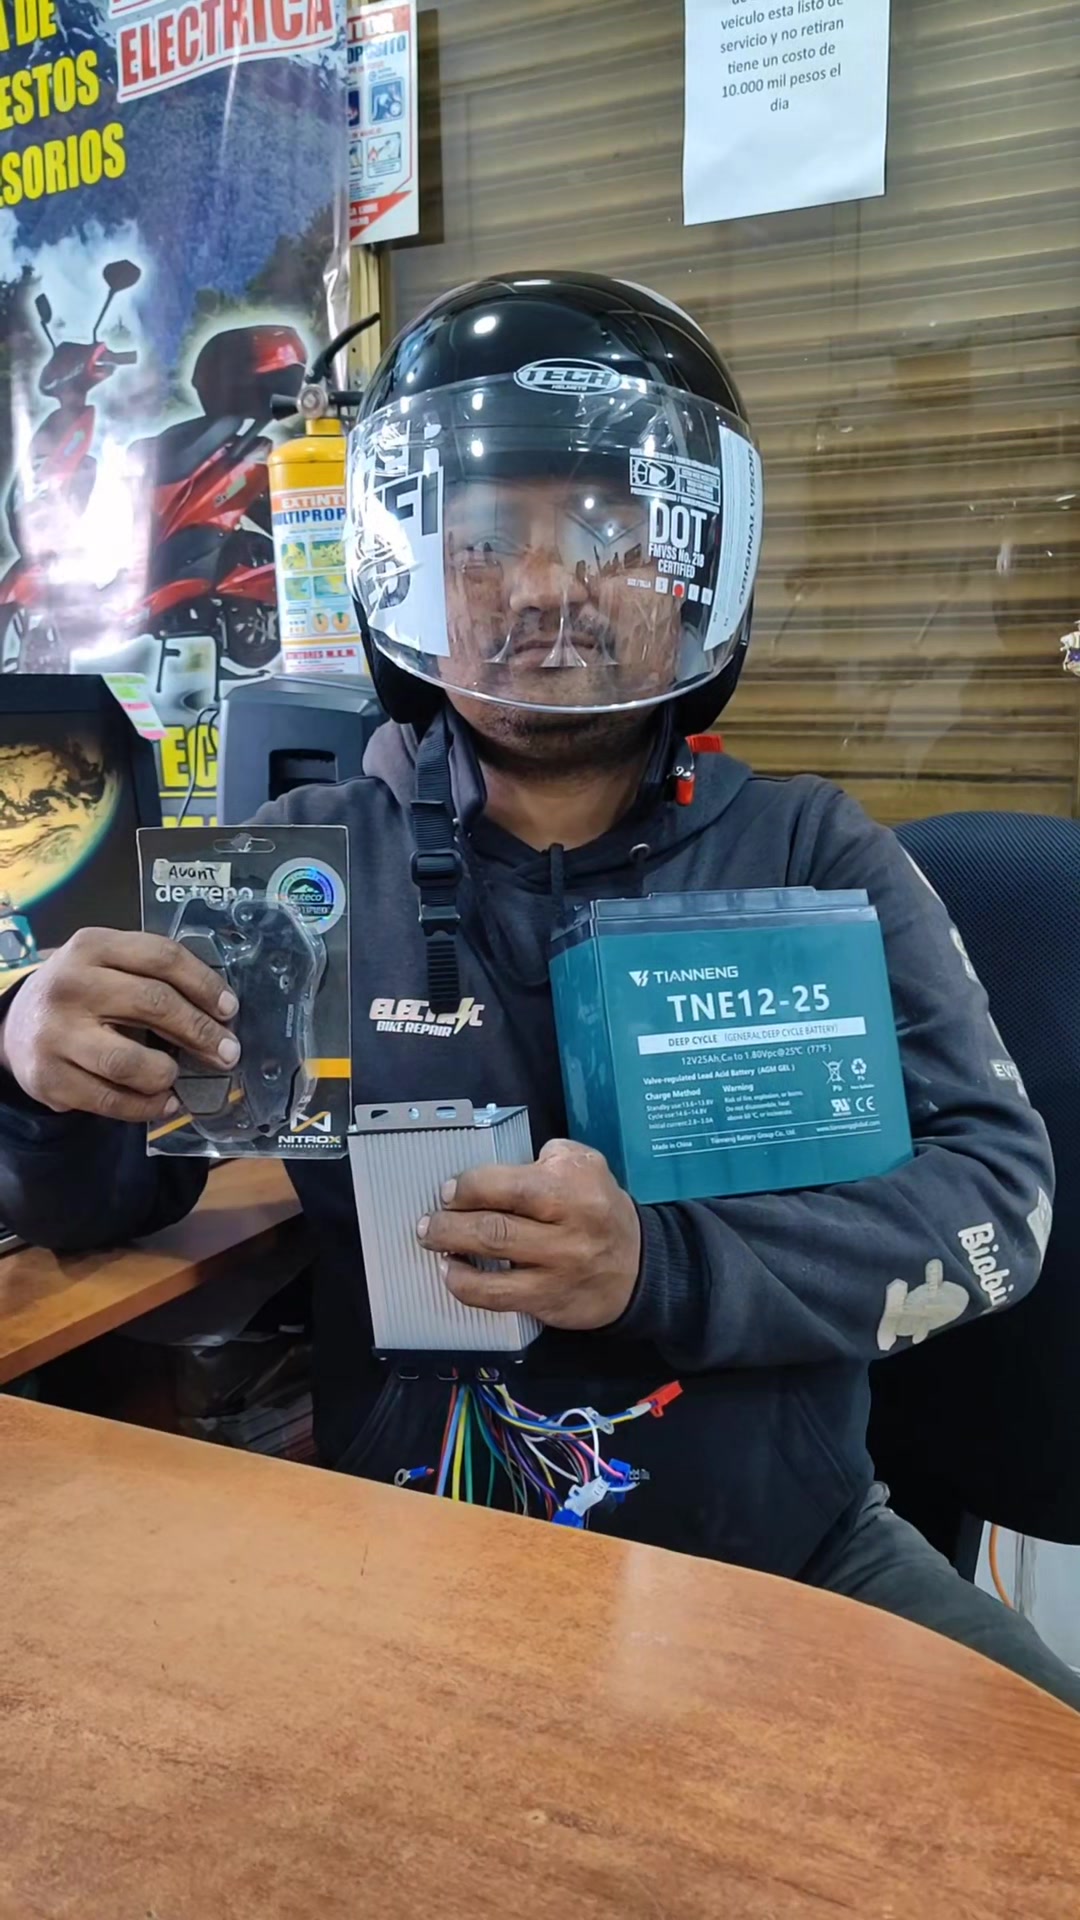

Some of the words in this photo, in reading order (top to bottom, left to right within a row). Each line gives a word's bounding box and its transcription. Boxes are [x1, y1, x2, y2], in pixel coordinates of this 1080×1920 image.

[14, 0, 57, 46] DE
[721, 10, 765, 30] veiculo
[768, 6, 794, 20] esta
[798, 0, 824, 13] listo
[120, 0, 333, 87] ELECTRICA
[721, 33, 767, 53] servicio
[770, 32, 778, 46] y
[781, 28, 798, 40] no
[801, 18, 844, 36] retiran
[728, 58, 759, 75] tiene
[763, 55, 778, 68] un
[782, 47, 816, 63] costo
[819, 42, 835, 56] de
[0, 49, 99, 130] ESTOS
[722, 78, 764, 98] 10.000
[767, 74, 786, 90] mil
[790, 68, 826, 88] pesos
[830, 63, 841, 77] el
[770, 98, 789, 112] dia
[0, 122, 126, 206] SORIOS
[526, 370, 612, 386] TECH
[650, 501, 707, 552] DOT
[739, 511, 755, 605] ORIGINAL
[747, 448, 757, 508] VISOR
[649, 543, 677, 560] FMVSS
[678, 548, 690, 562] No.
[658, 559, 695, 579] CERTIFIED
[155, 884, 185, 902] de
[653, 966, 739, 984] TIANNENG
[667, 984, 830, 1022] TNE12-25
[376, 1020, 405, 1033] BIKE
[405, 1021, 453, 1037] REPAIR
[668, 1037, 690, 1047] DEEP
[692, 1034, 717, 1045] CYCLE
[762, 1028, 781, 1039] DEEP
[782, 1026, 804, 1037] CYCLE
[734, 1052, 743, 1061] to
[643, 1072, 696, 1085] Valve-regulated
[697, 1071, 713, 1080] Lead
[715, 1069, 729, 1078] Acid
[731, 1067, 755, 1077] Battery
[645, 1091, 671, 1101] Charge
[672, 1088, 701, 1098] Method
[722, 1083, 754, 1092] Warning
[856, 1096, 876, 1112] CE
[278, 1135, 341, 1144] NITROX
